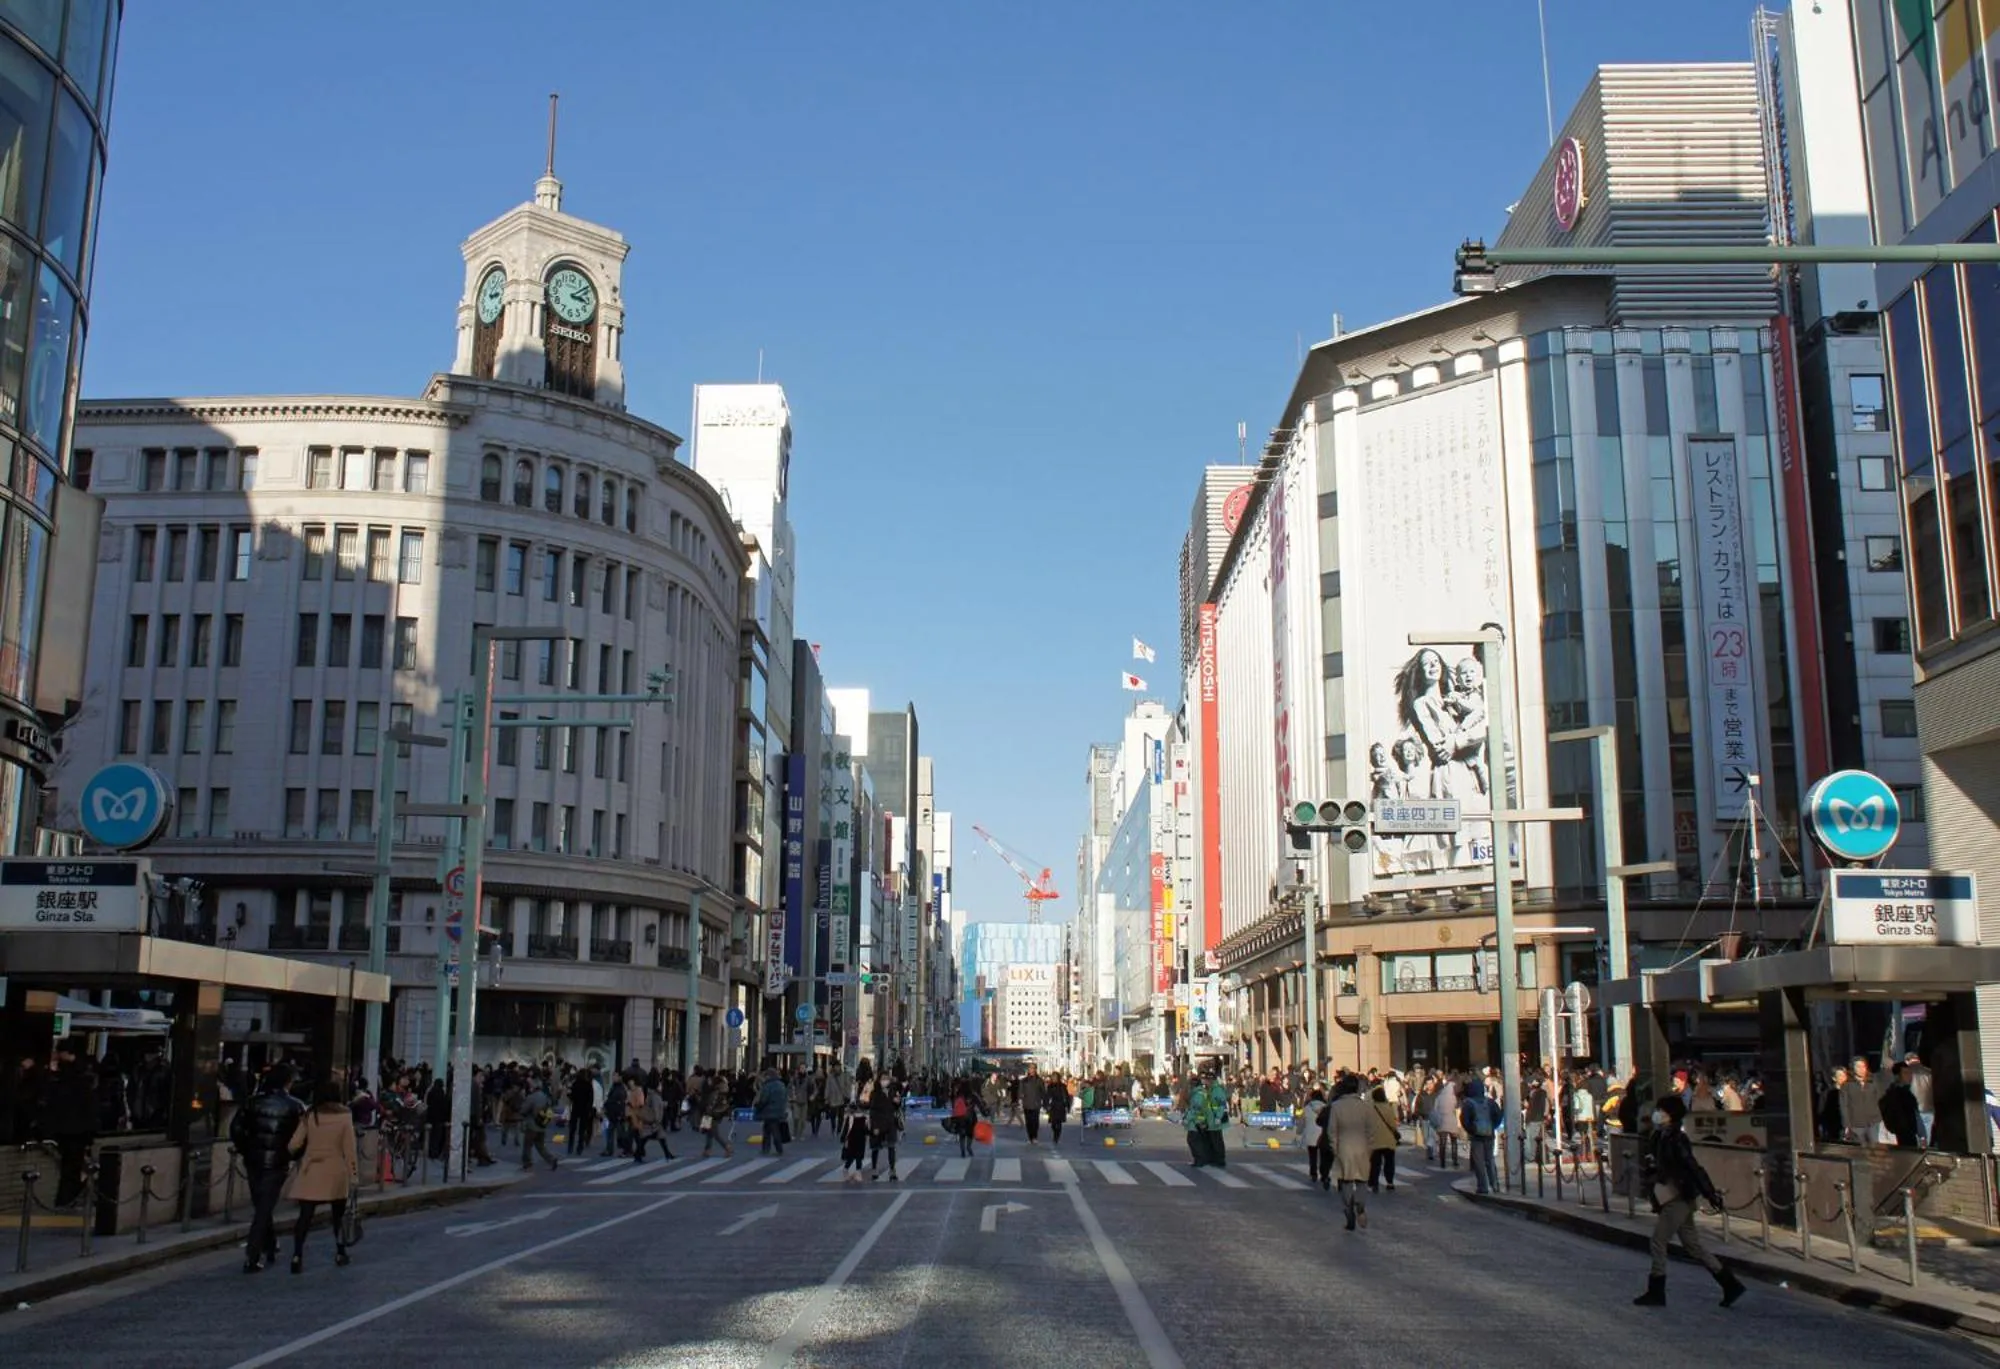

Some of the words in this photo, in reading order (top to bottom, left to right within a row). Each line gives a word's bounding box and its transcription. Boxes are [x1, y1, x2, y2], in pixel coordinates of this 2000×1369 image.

[550, 323, 592, 344] SEIKO
[1201, 610, 1215, 703] MITSUKOSHI
[1381, 807, 1456, 821] 銀座四丁目
[1880, 879, 1928, 889] 東京メトロ
[1884, 889, 1903, 897] Tokyo
[1904, 889, 1925, 897] Metro
[36, 890, 98, 910] 銀座駅
[35, 910, 70, 922] Ginza
[73, 910, 95, 922] Sta.
[1874, 904, 1937, 923] 銀座駅
[1876, 924, 1911, 936] Ginza
[1914, 924, 1937, 936] Sta.
[1010, 968, 1048, 981] LIXIL
